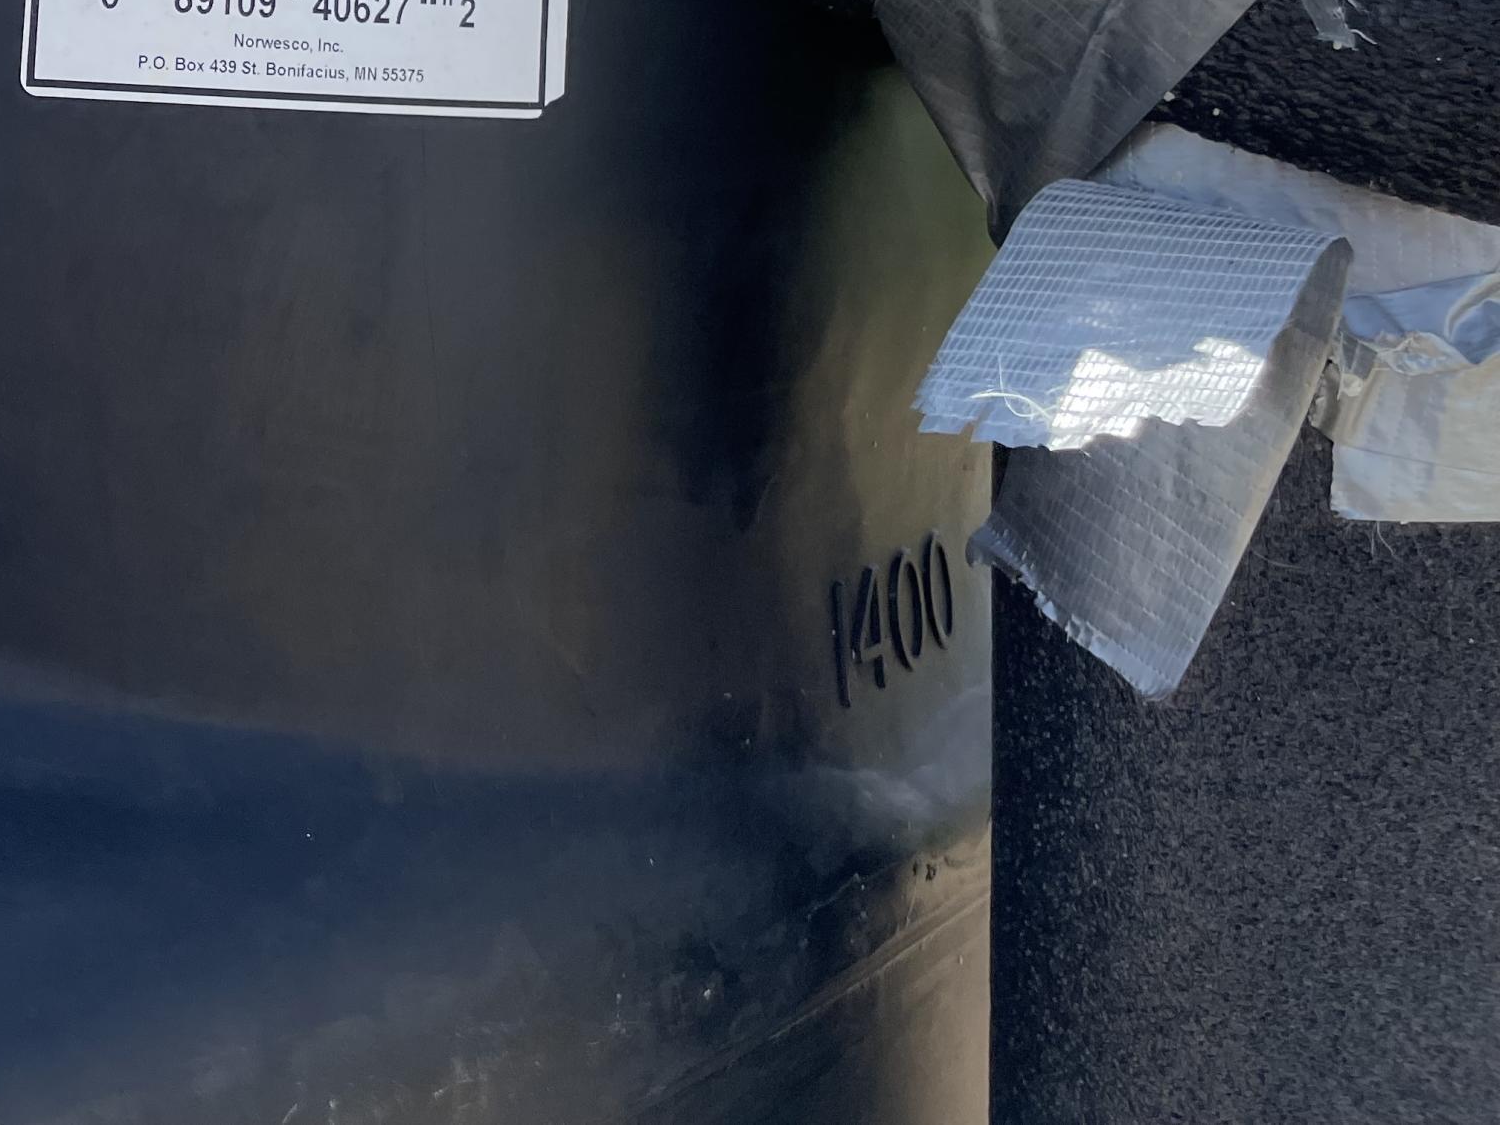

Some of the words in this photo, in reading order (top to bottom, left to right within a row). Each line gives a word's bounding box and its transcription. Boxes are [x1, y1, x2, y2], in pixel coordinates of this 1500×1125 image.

[233, 33, 313, 54] Norwesco,
[317, 37, 344, 53] Inc.
[137, 54, 169, 71] P.O.
[174, 56, 205, 73] Box
[209, 59, 237, 74] 439
[241, 61, 261, 76] St.
[265, 62, 350, 82] Bonifacius,
[353, 66, 378, 82] MN
[381, 67, 425, 83] 55375
[830, 529, 954, 709] 1400
